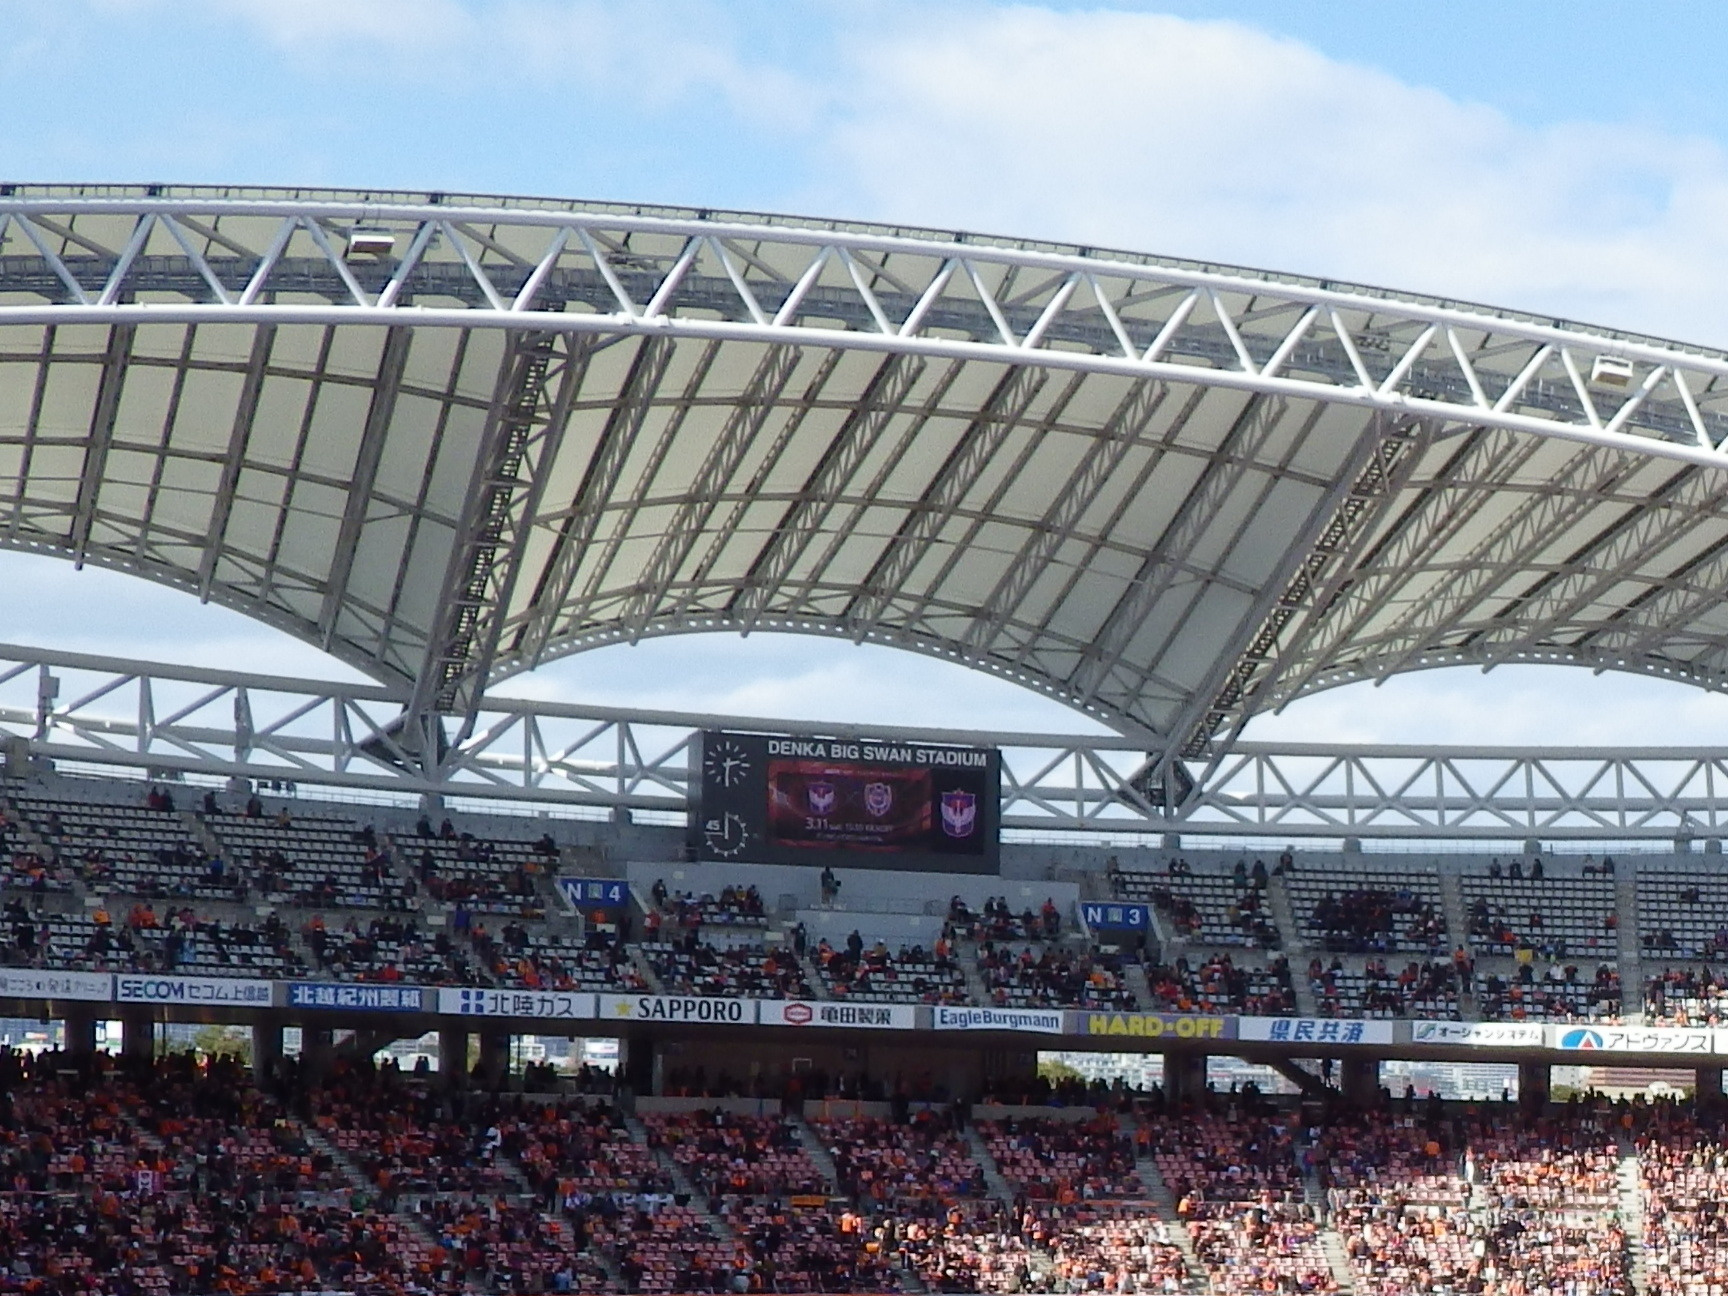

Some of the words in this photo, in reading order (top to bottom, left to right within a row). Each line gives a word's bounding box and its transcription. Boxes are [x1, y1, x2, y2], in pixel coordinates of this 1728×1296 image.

[768, 740, 826, 758] DENKA
[830, 743, 859, 760] BIG
[863, 745, 912, 763] SWAN
[915, 748, 987, 767] STADIUM
[568, 883, 581, 900] N
[609, 886, 620, 901] 4
[1087, 907, 1101, 922] N
[1129, 909, 1140, 924] 3
[121, 981, 184, 1000] SECOM
[489, 994, 574, 1017] 北陸ガス
[638, 997, 743, 1022] SAPPORO
[820, 1006, 892, 1026] 亀田製菓
[940, 1008, 1060, 1030] EagleBurgmann
[1269, 1019, 1364, 1042] 県民共済
[1437, 1024, 1540, 1042] オーシャンシステム
[1607, 1031, 1707, 1051] アドヴァンス
